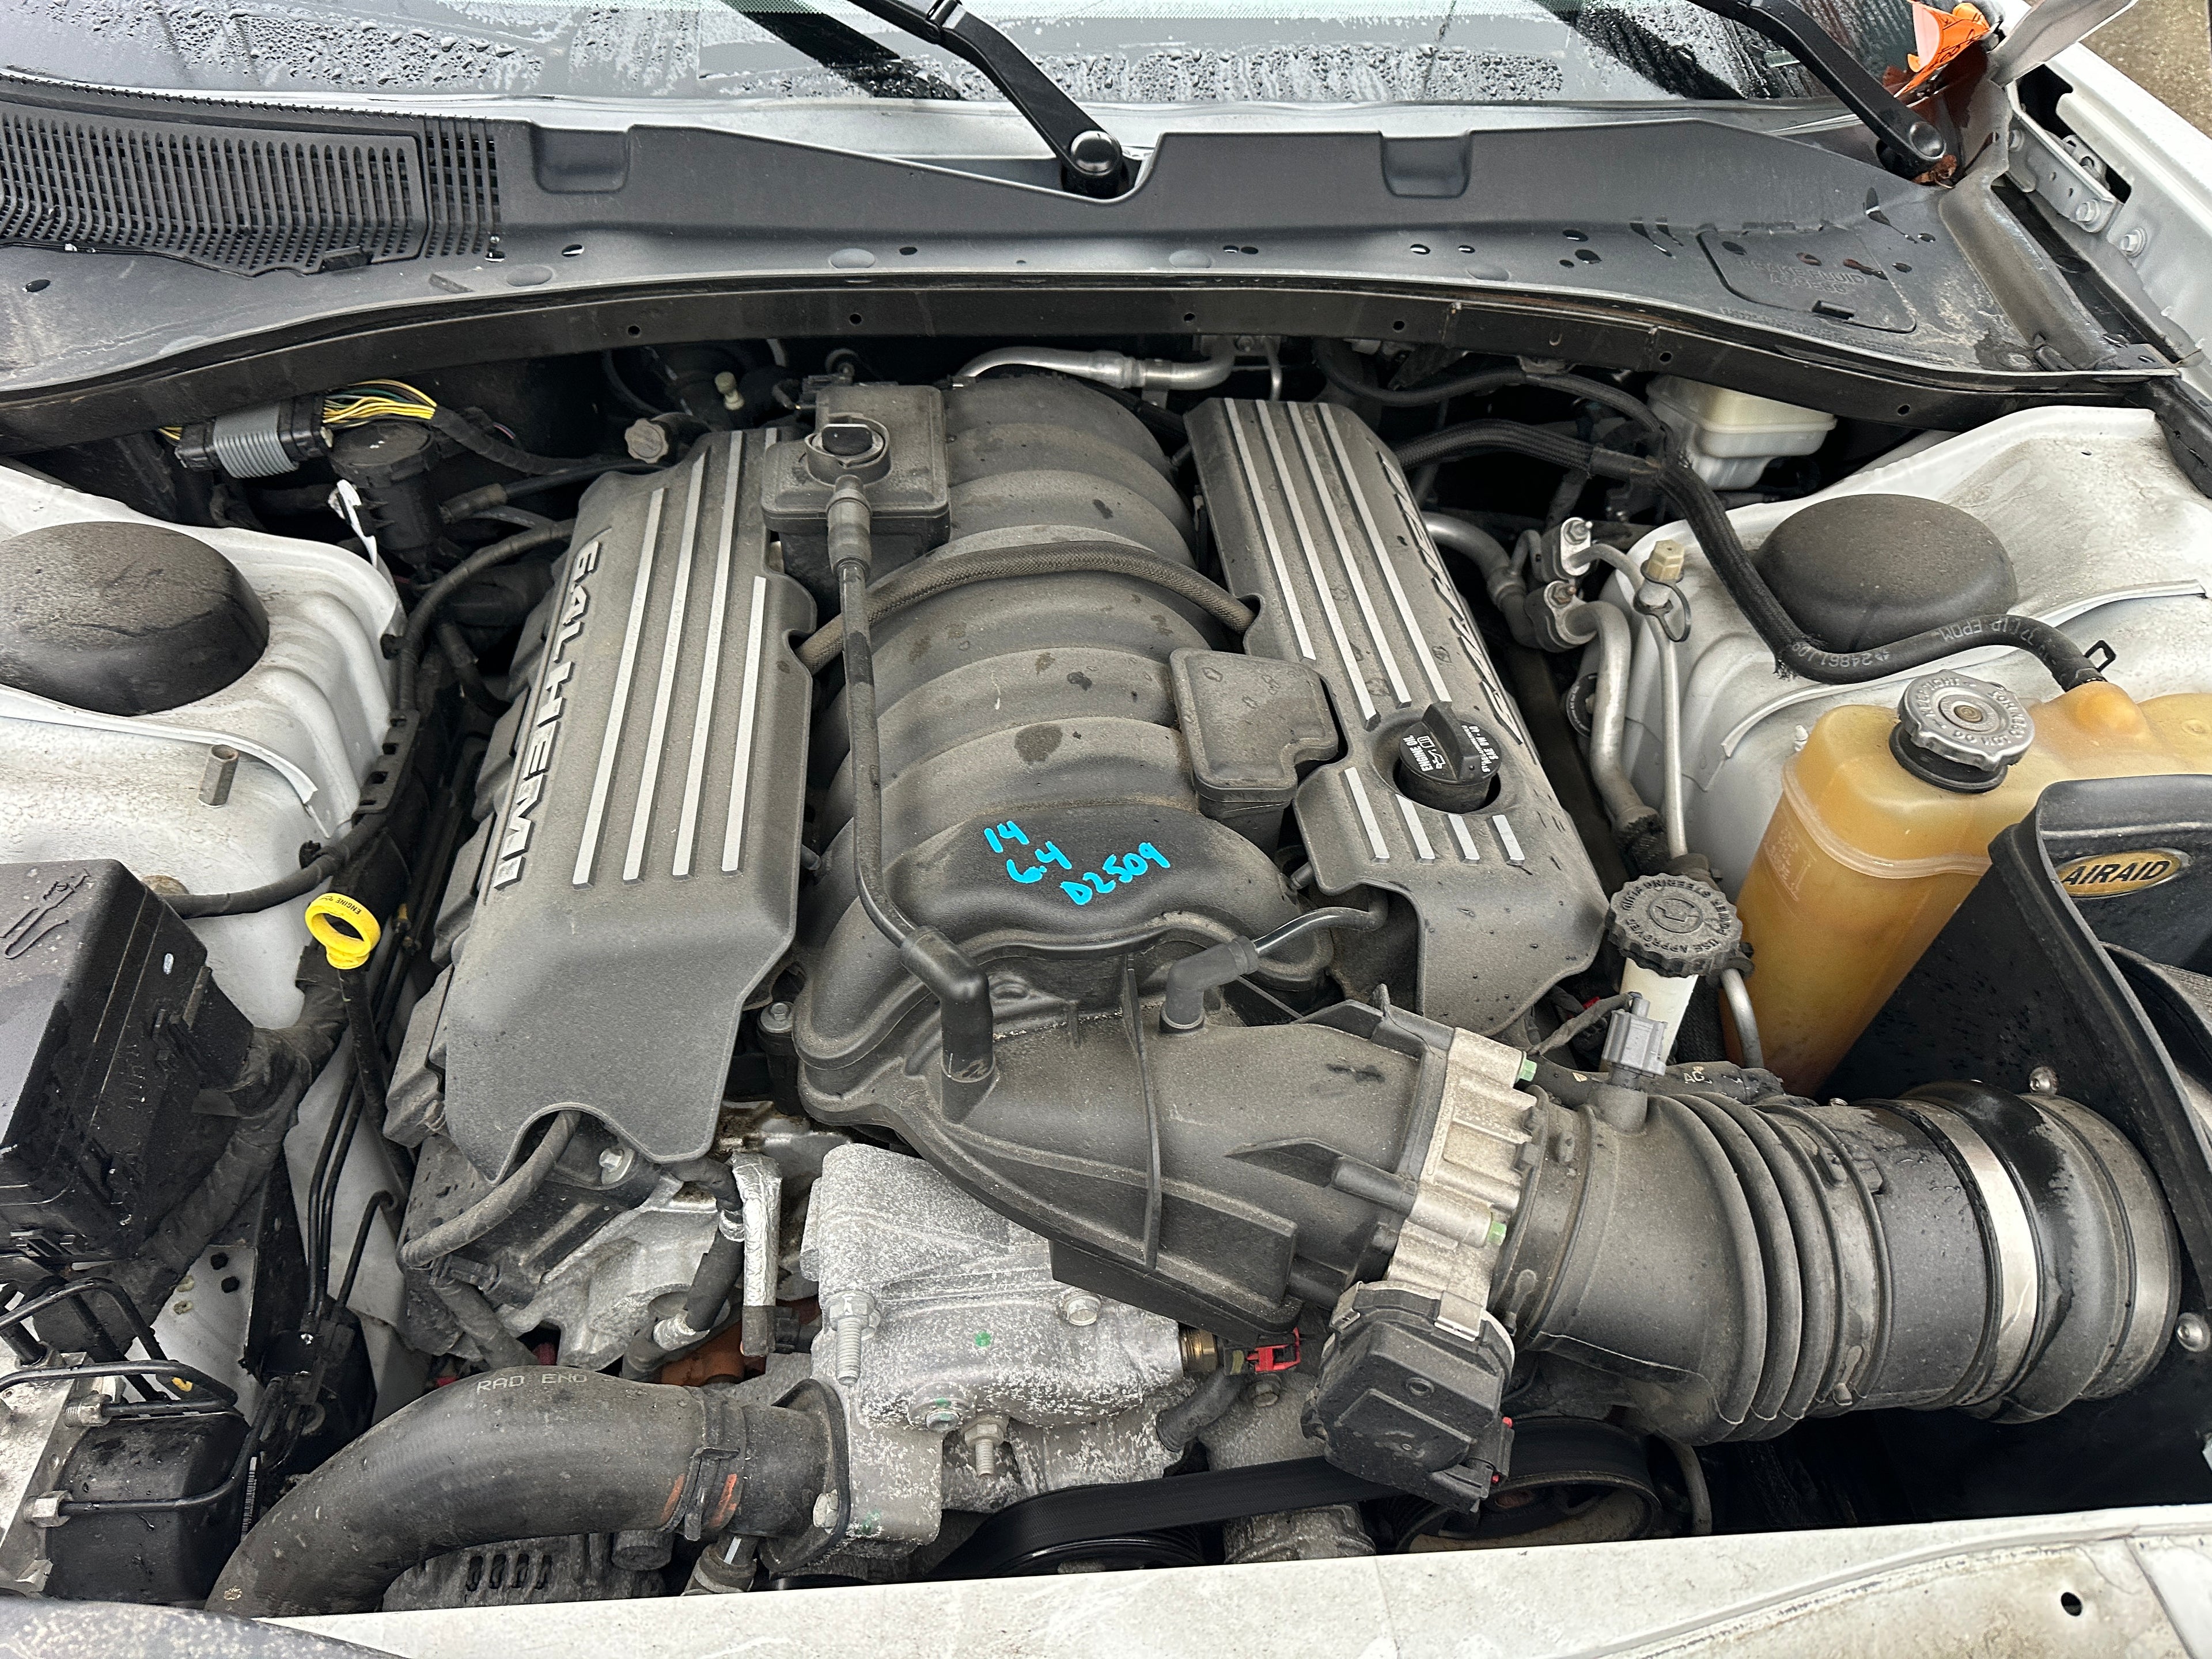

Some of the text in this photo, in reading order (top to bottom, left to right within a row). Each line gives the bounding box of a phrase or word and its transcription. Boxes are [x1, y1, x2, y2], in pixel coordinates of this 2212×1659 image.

[1403, 734, 1434, 772] ENGINE OIL
[1954, 729, 1978, 744] DO
[1483, 748, 1499, 760] SAE
[493, 660, 575, 891] HEMI
[983, 820, 1030, 854] 14
[1006, 840, 1073, 884] 6.4
[1060, 842, 1171, 906] D2509
[2061, 859, 2172, 886] AIRAID
[335, 897, 362, 915] ENGINE
[1625, 918, 1721, 954] USE APPROVED
[476, 1373, 588, 1395] RAD END
